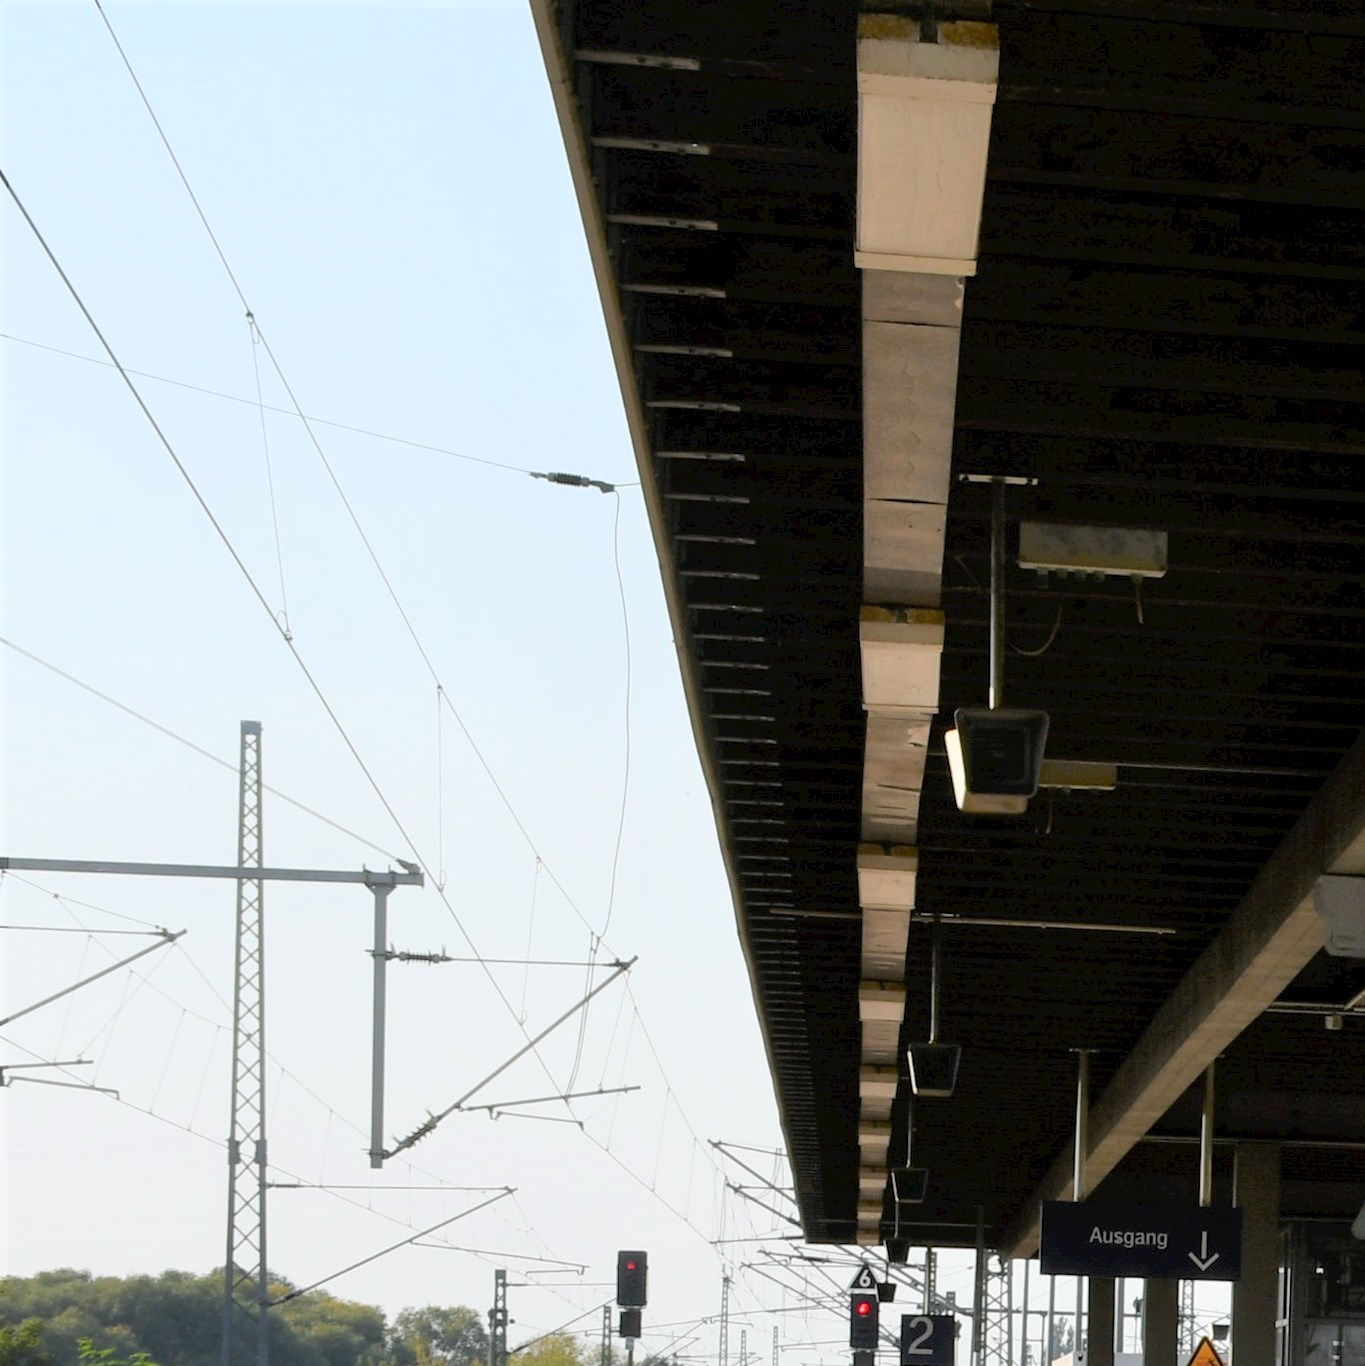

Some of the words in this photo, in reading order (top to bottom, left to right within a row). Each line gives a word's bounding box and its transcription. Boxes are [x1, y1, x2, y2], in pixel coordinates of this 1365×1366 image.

[1089, 1226, 1168, 1249] Ausgang
[859, 1268, 871, 1287] 6
[908, 1315, 934, 1355] 2
